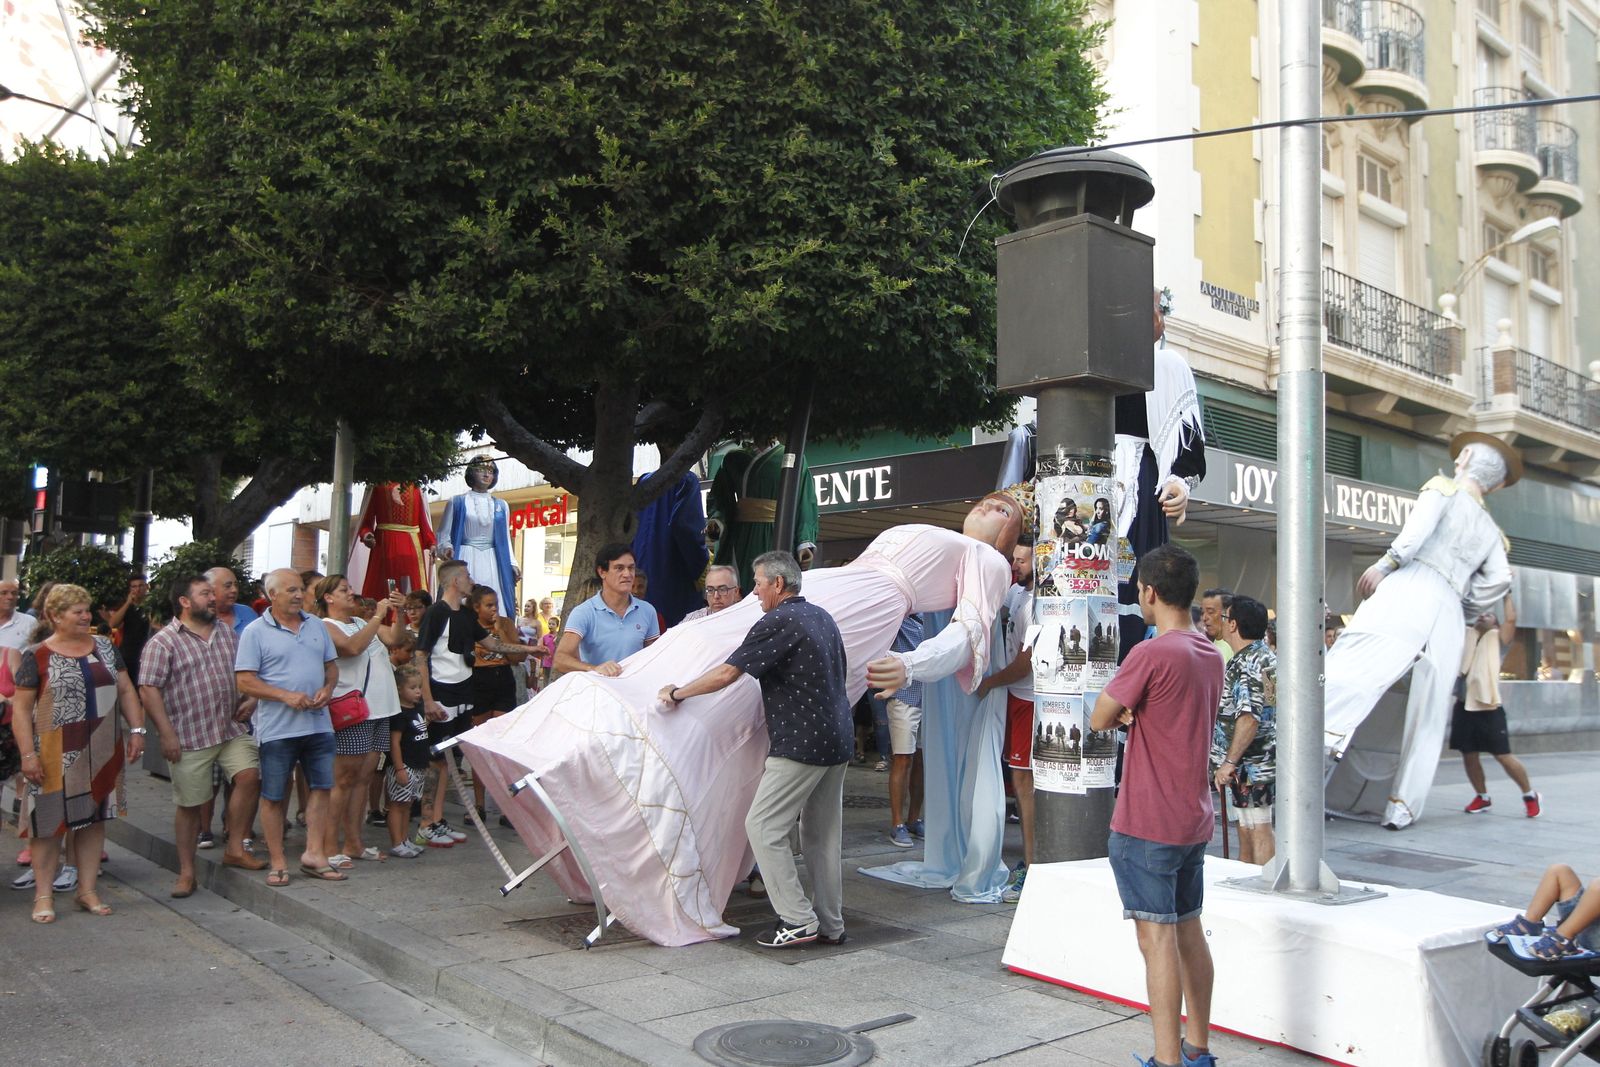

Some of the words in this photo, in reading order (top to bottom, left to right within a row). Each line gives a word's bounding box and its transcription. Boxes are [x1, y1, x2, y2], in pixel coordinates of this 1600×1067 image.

[813, 465, 892, 506] ENTE
[1230, 463, 1277, 505] JOY
[1336, 484, 1416, 527] REGENT
[509, 494, 568, 538] ptical
[1067, 664, 1083, 673] MAR
